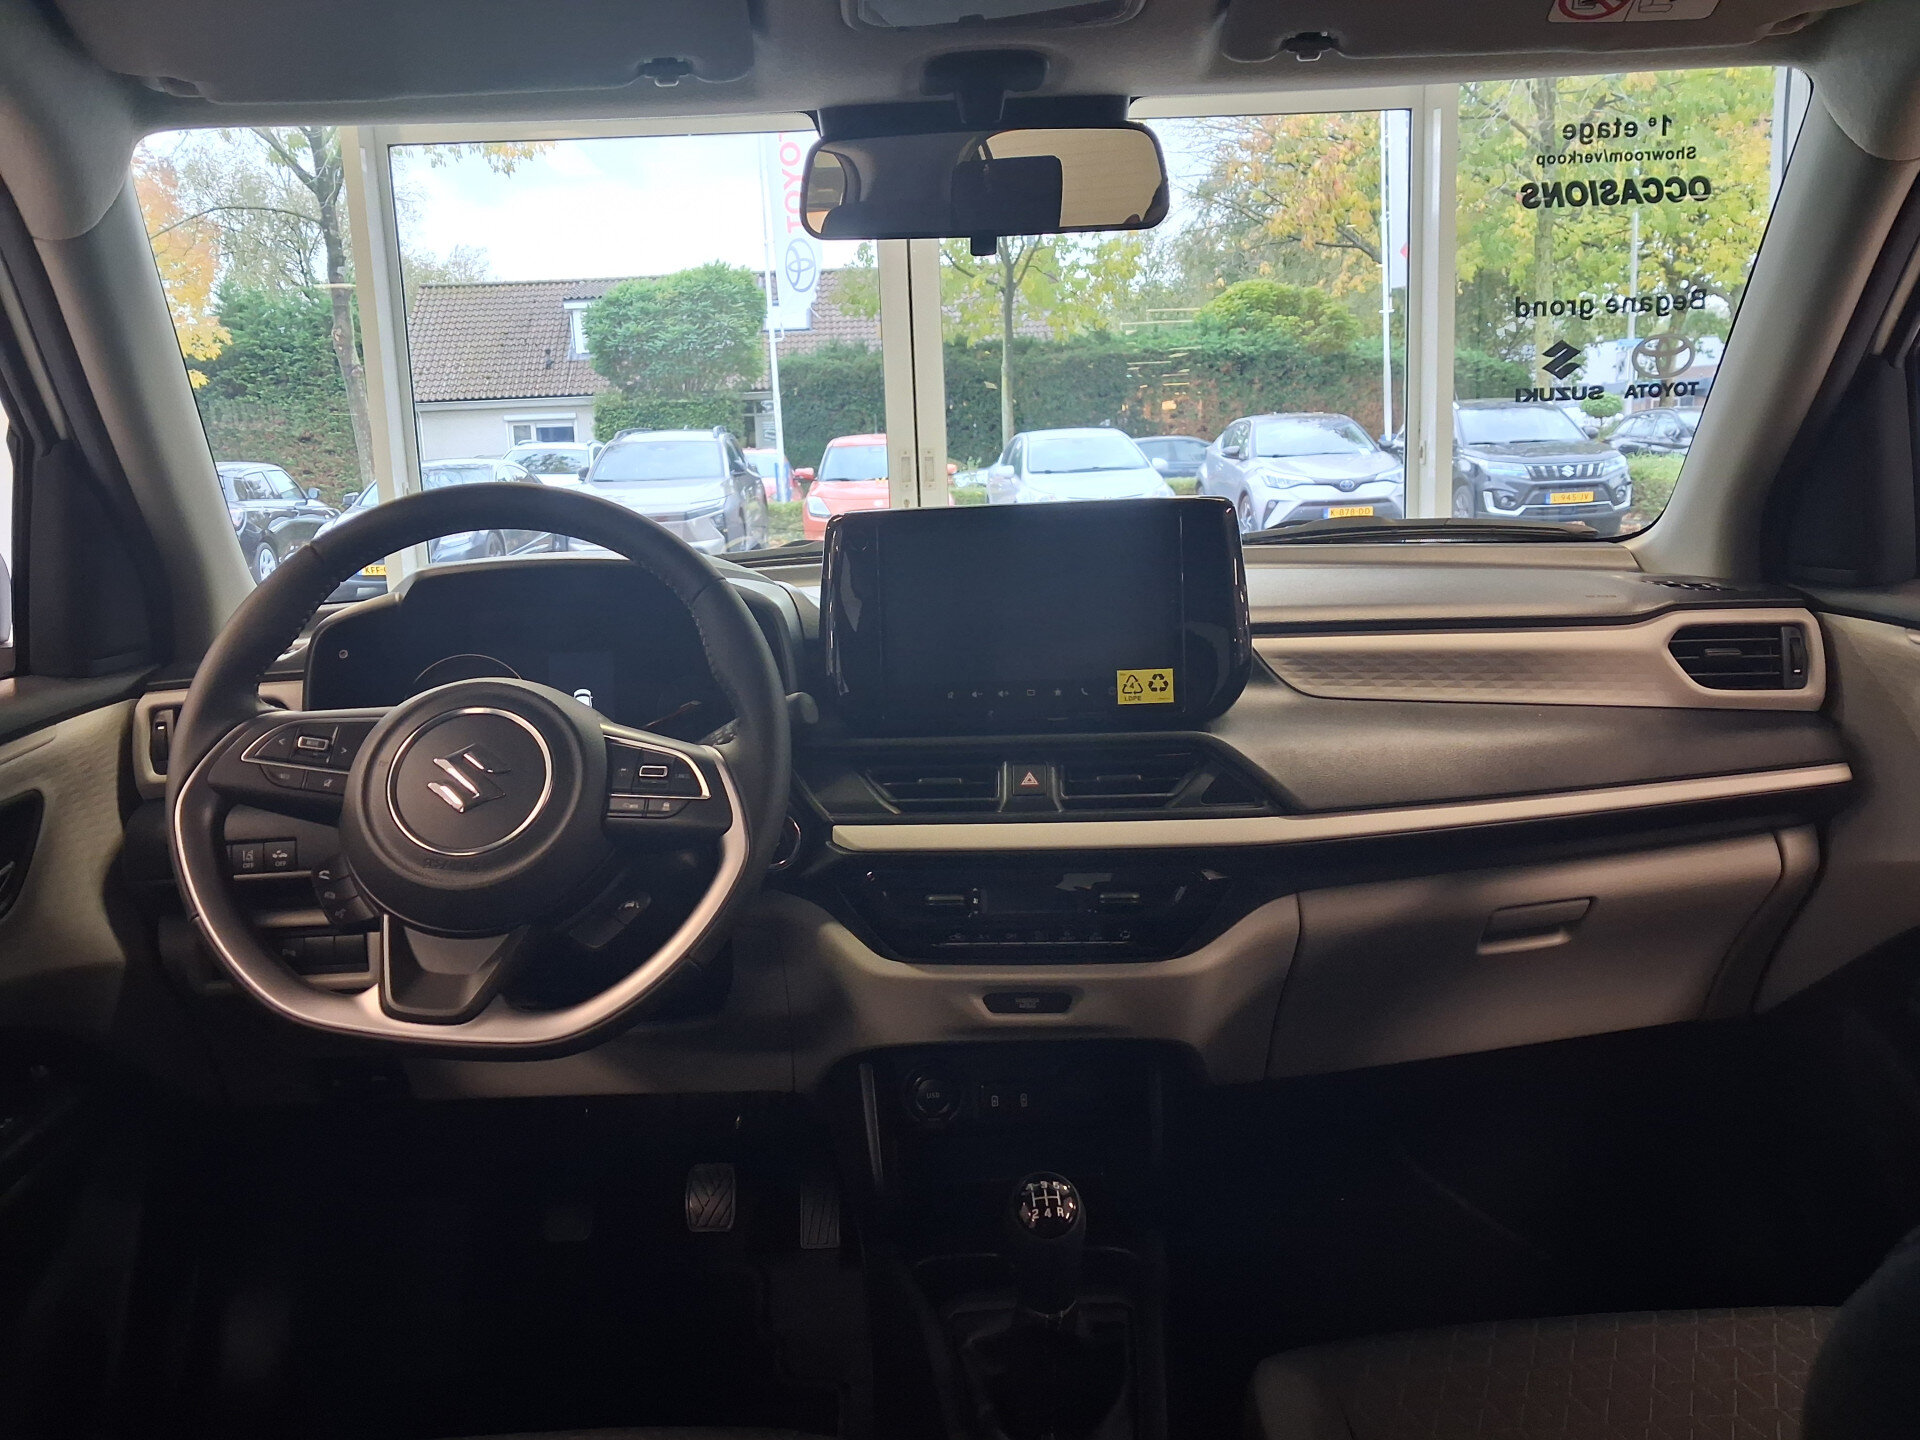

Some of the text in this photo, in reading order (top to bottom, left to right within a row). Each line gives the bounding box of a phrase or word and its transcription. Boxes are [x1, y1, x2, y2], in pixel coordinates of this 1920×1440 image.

[779, 132, 803, 234] TOYO
[1031, 1207, 1064, 1219] 2 4 R
